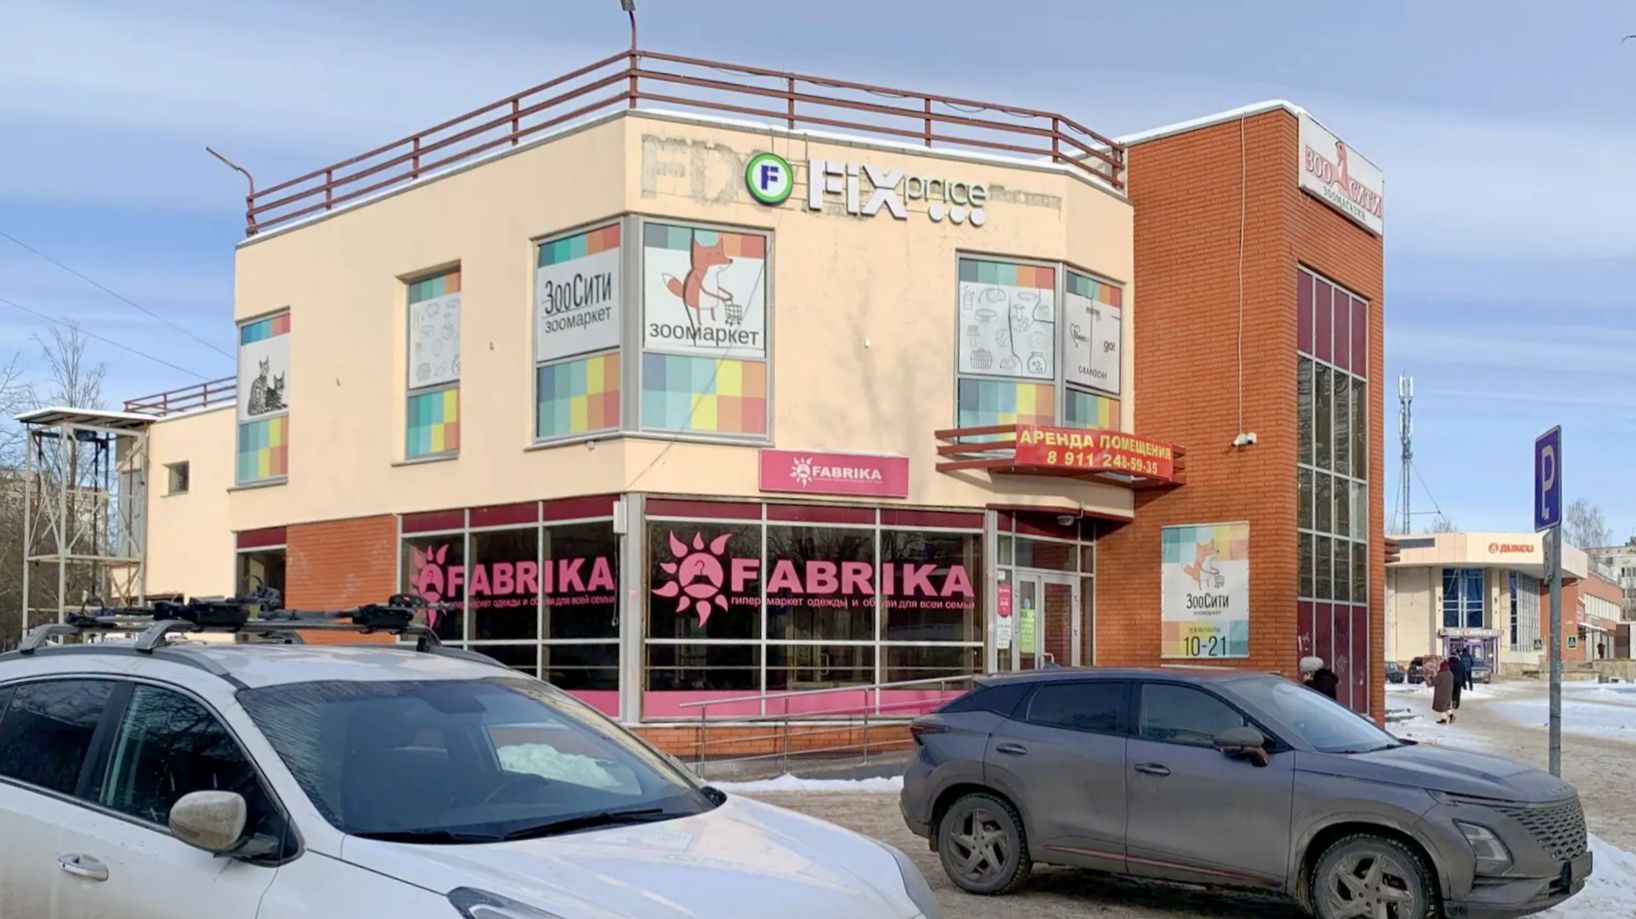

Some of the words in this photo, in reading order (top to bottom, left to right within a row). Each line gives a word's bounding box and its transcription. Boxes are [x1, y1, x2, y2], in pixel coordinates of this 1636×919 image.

[545, 306, 612, 334] зоомаркет
[649, 322, 760, 347] зоомаркет
[1020, 430, 1094, 449] АРЕНДА
[1100, 435, 1171, 460] ПОМЕЩЕНИЯ
[1047, 450, 1057, 465] 8
[1064, 451, 1094, 467] 911
[812, 466, 882, 480] FABRIKA
[447, 556, 615, 598] FABRIKA
[730, 558, 975, 598] FABRIKA
[898, 601, 918, 609] для
[1184, 635, 1226, 657] 10-21
